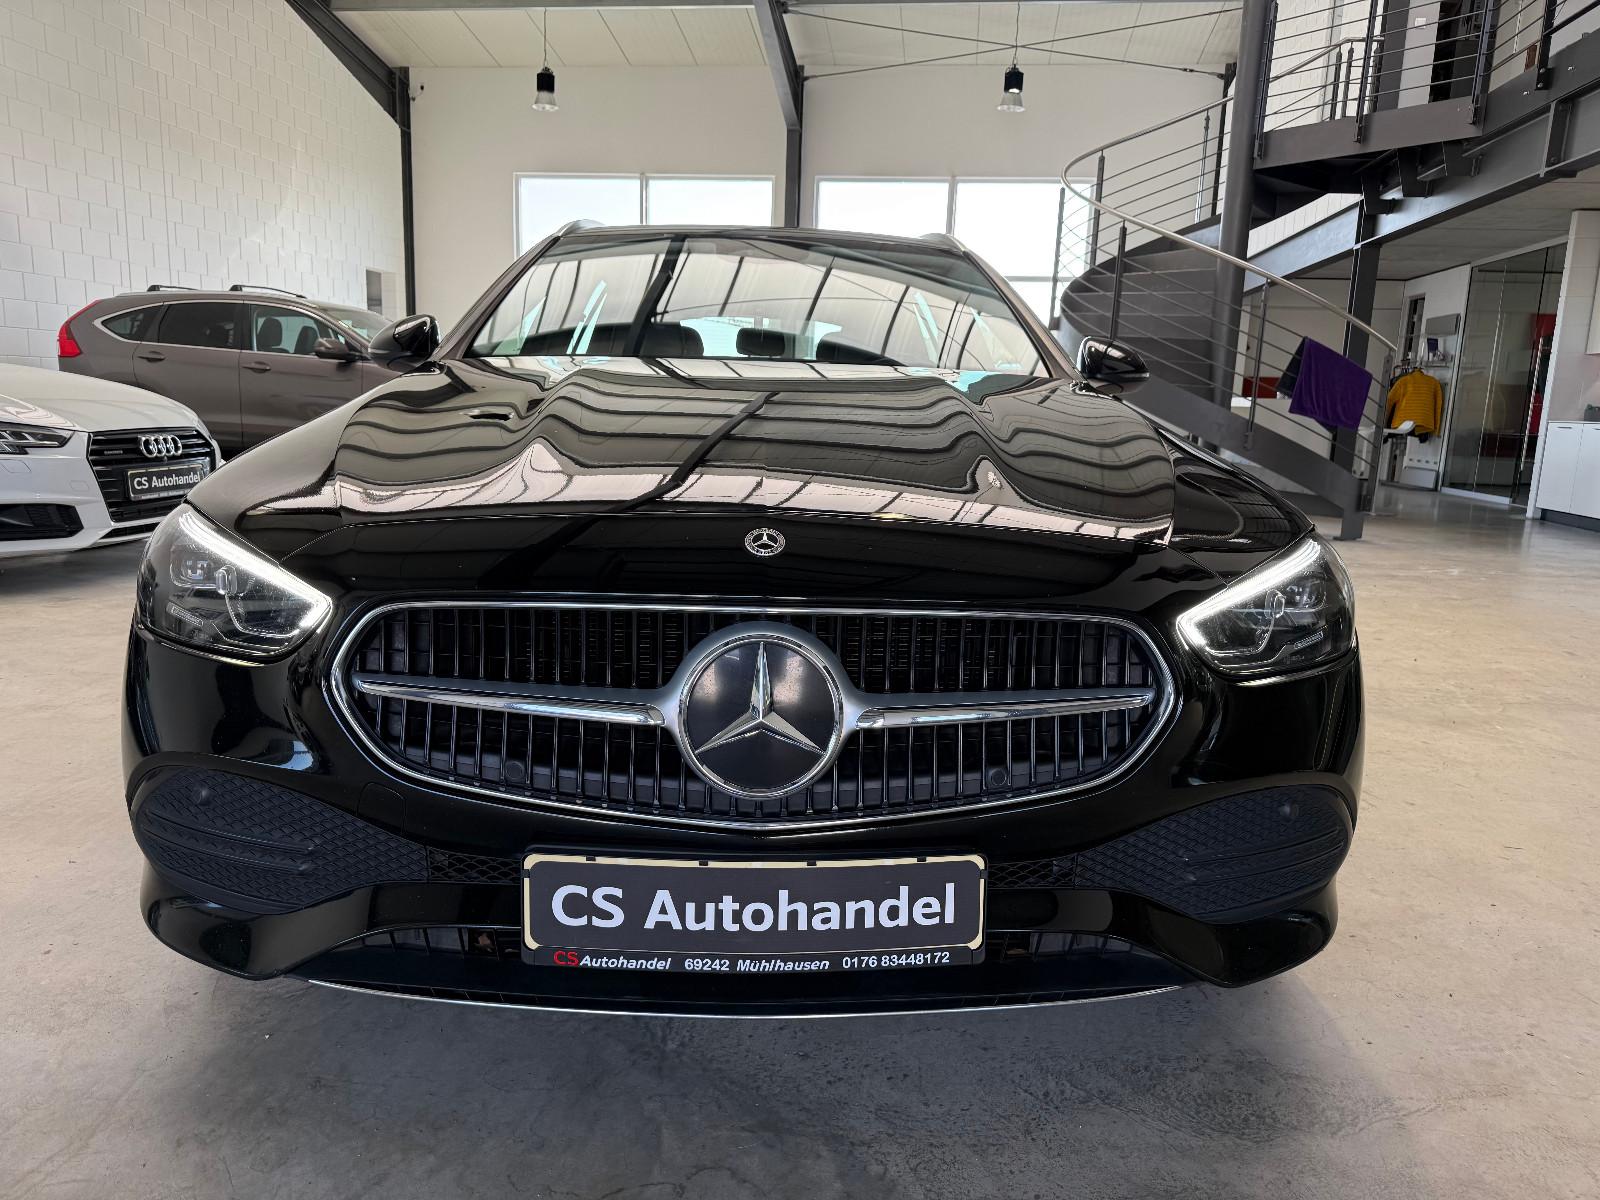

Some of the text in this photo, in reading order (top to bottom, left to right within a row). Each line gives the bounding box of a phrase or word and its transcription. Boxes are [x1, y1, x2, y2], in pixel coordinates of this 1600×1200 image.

[133, 472, 200, 489] CS Autohandel
[551, 882, 955, 932] CS Autohandel
[684, 958, 730, 971] 69242
[736, 959, 830, 972] Mühlhausen
[842, 956, 878, 968] 0176
[881, 951, 950, 967] 83448172
